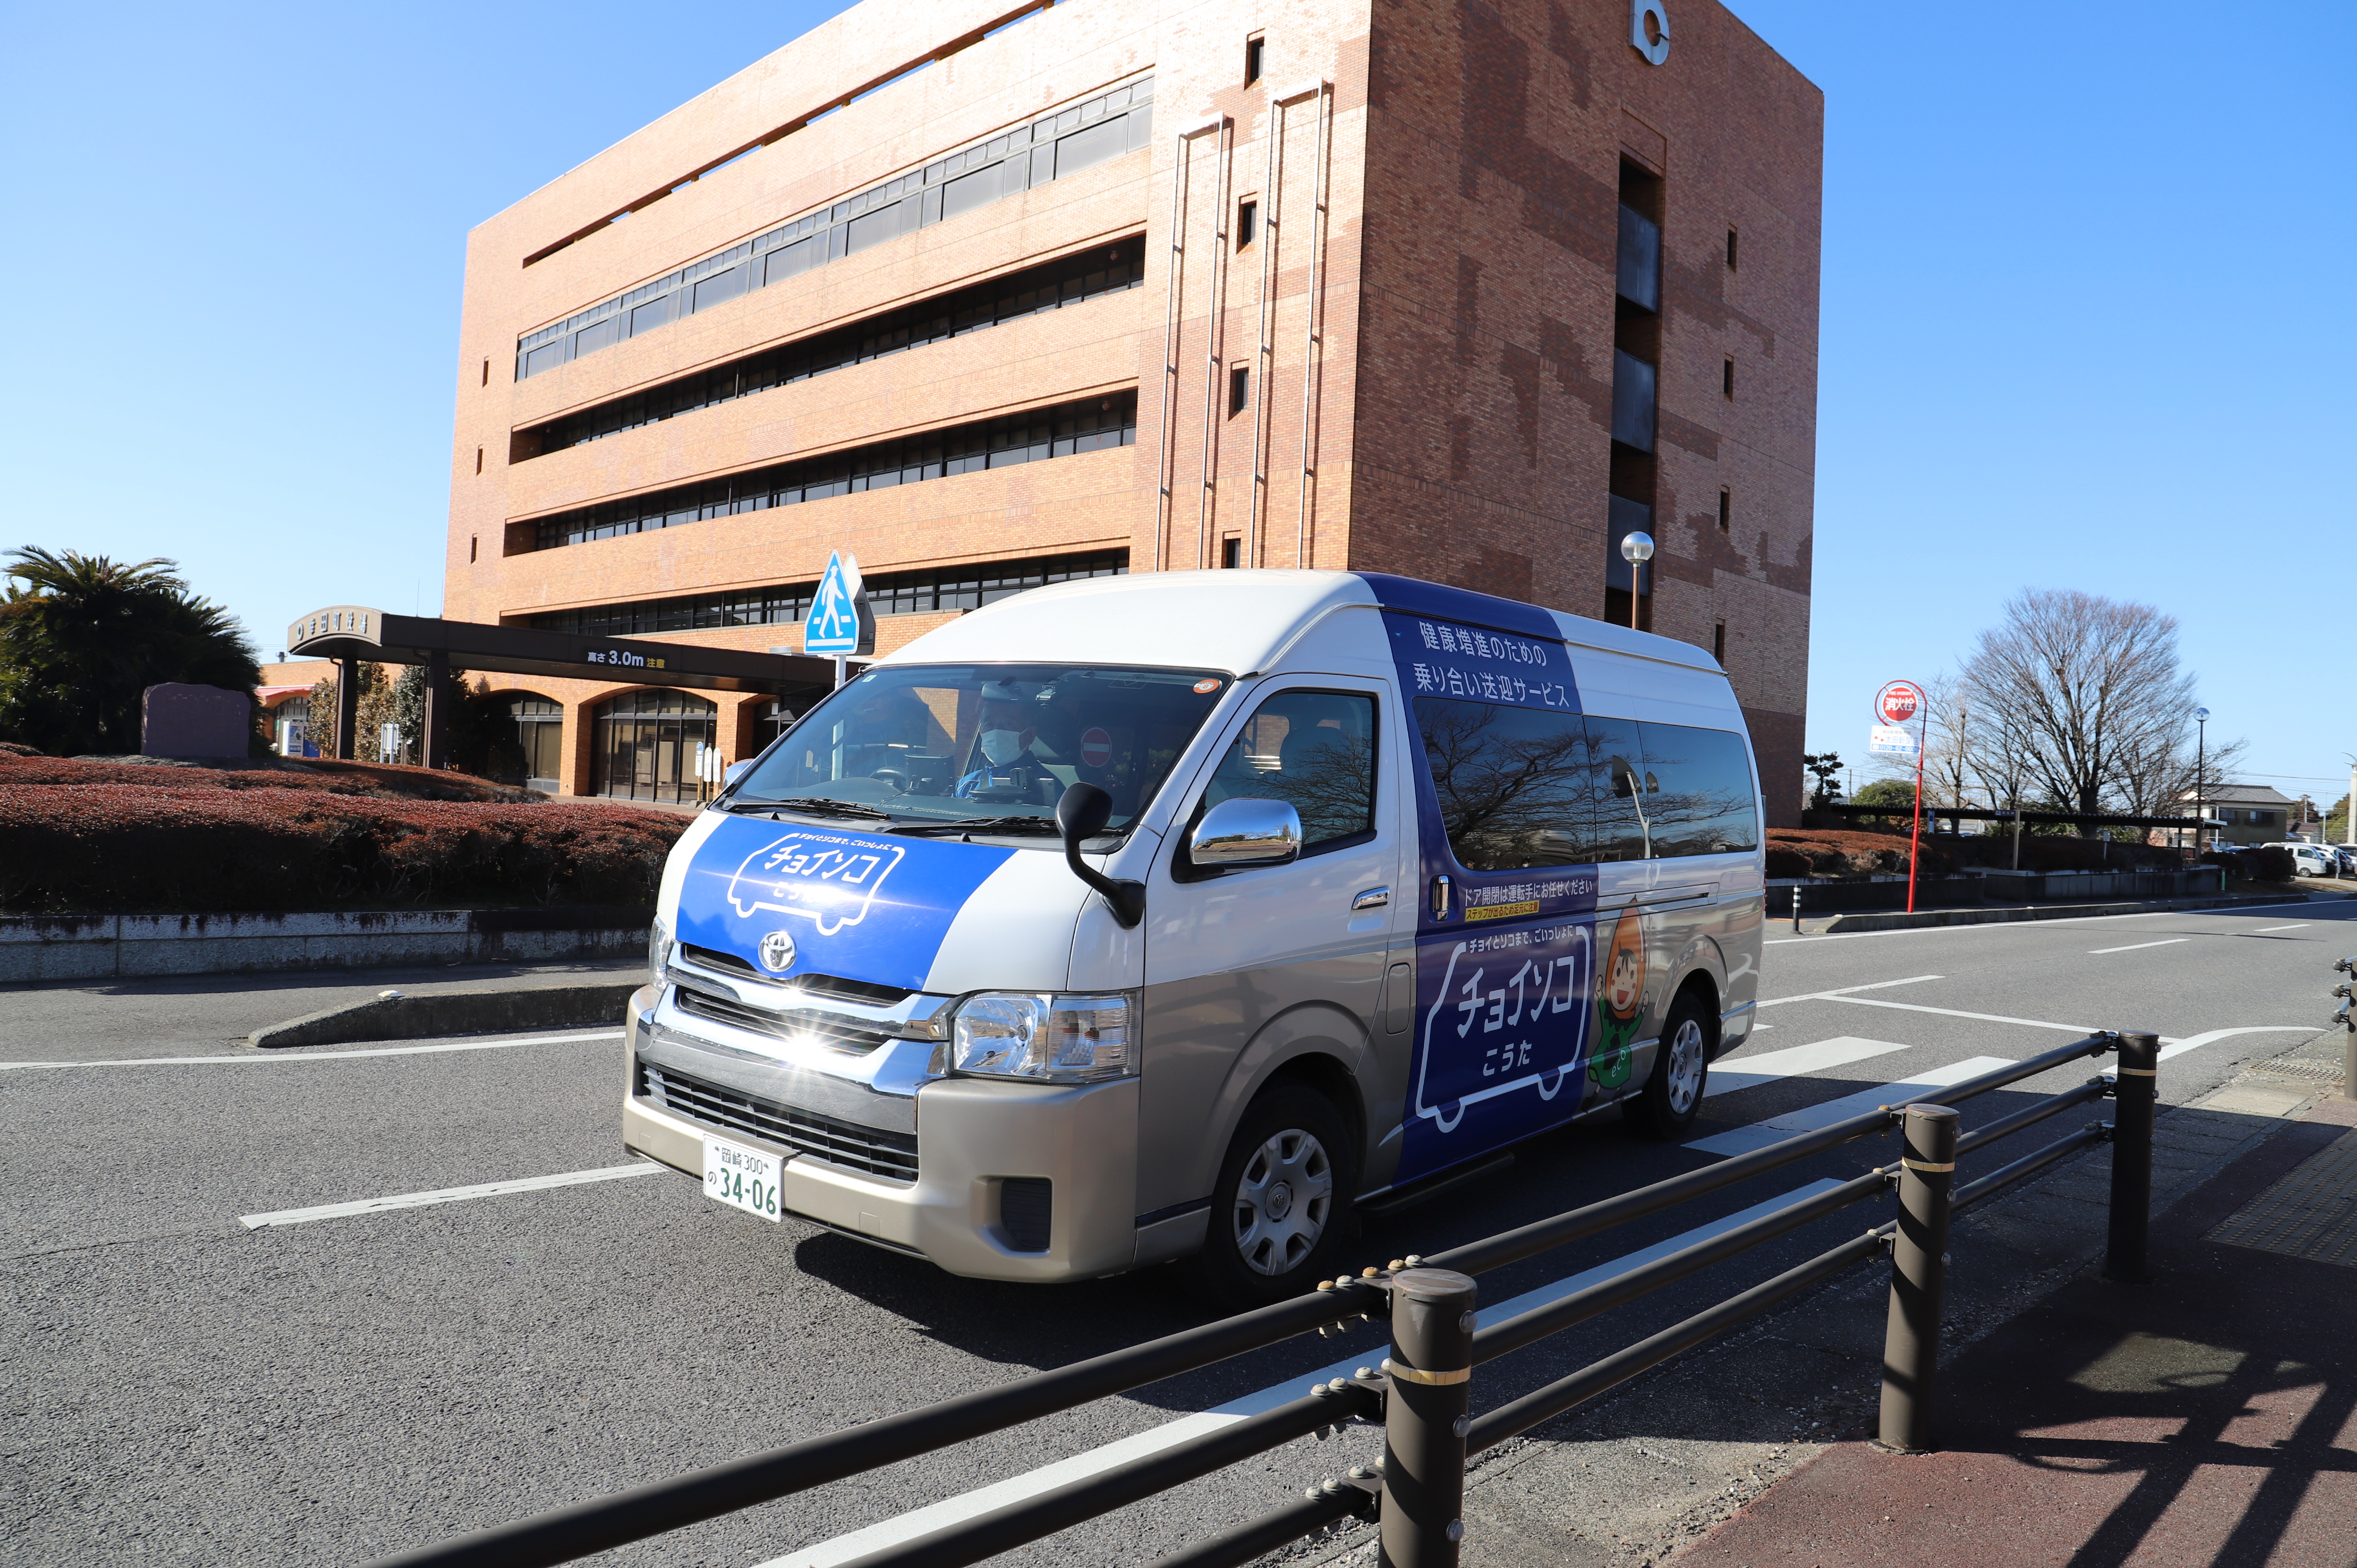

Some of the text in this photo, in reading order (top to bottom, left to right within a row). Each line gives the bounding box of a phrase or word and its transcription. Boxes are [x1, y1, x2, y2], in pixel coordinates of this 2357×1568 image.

[1419, 621, 1547, 667] 健康増進のための
[588, 650, 665, 668] 高さ 3.0m 注意
[1413, 662, 1569, 708] 乗り合い送迎サービス
[1885, 697, 1915, 711] 消火栓
[1885, 736, 1919, 745] 太田新聞店
[764, 843, 881, 884] チョイソコ
[1465, 879, 1592, 906] ドア開閉は運転手にお任せください
[1466, 901, 1539, 919] ステップが出るため足元に注意
[1457, 956, 1574, 1038] チョイソコ
[1483, 1040, 1531, 1076] こうた
[1611, 1050, 1626, 1077] eco
[722, 1147, 763, 1175] 岡崎 300
[708, 1168, 776, 1215] の 34-06
